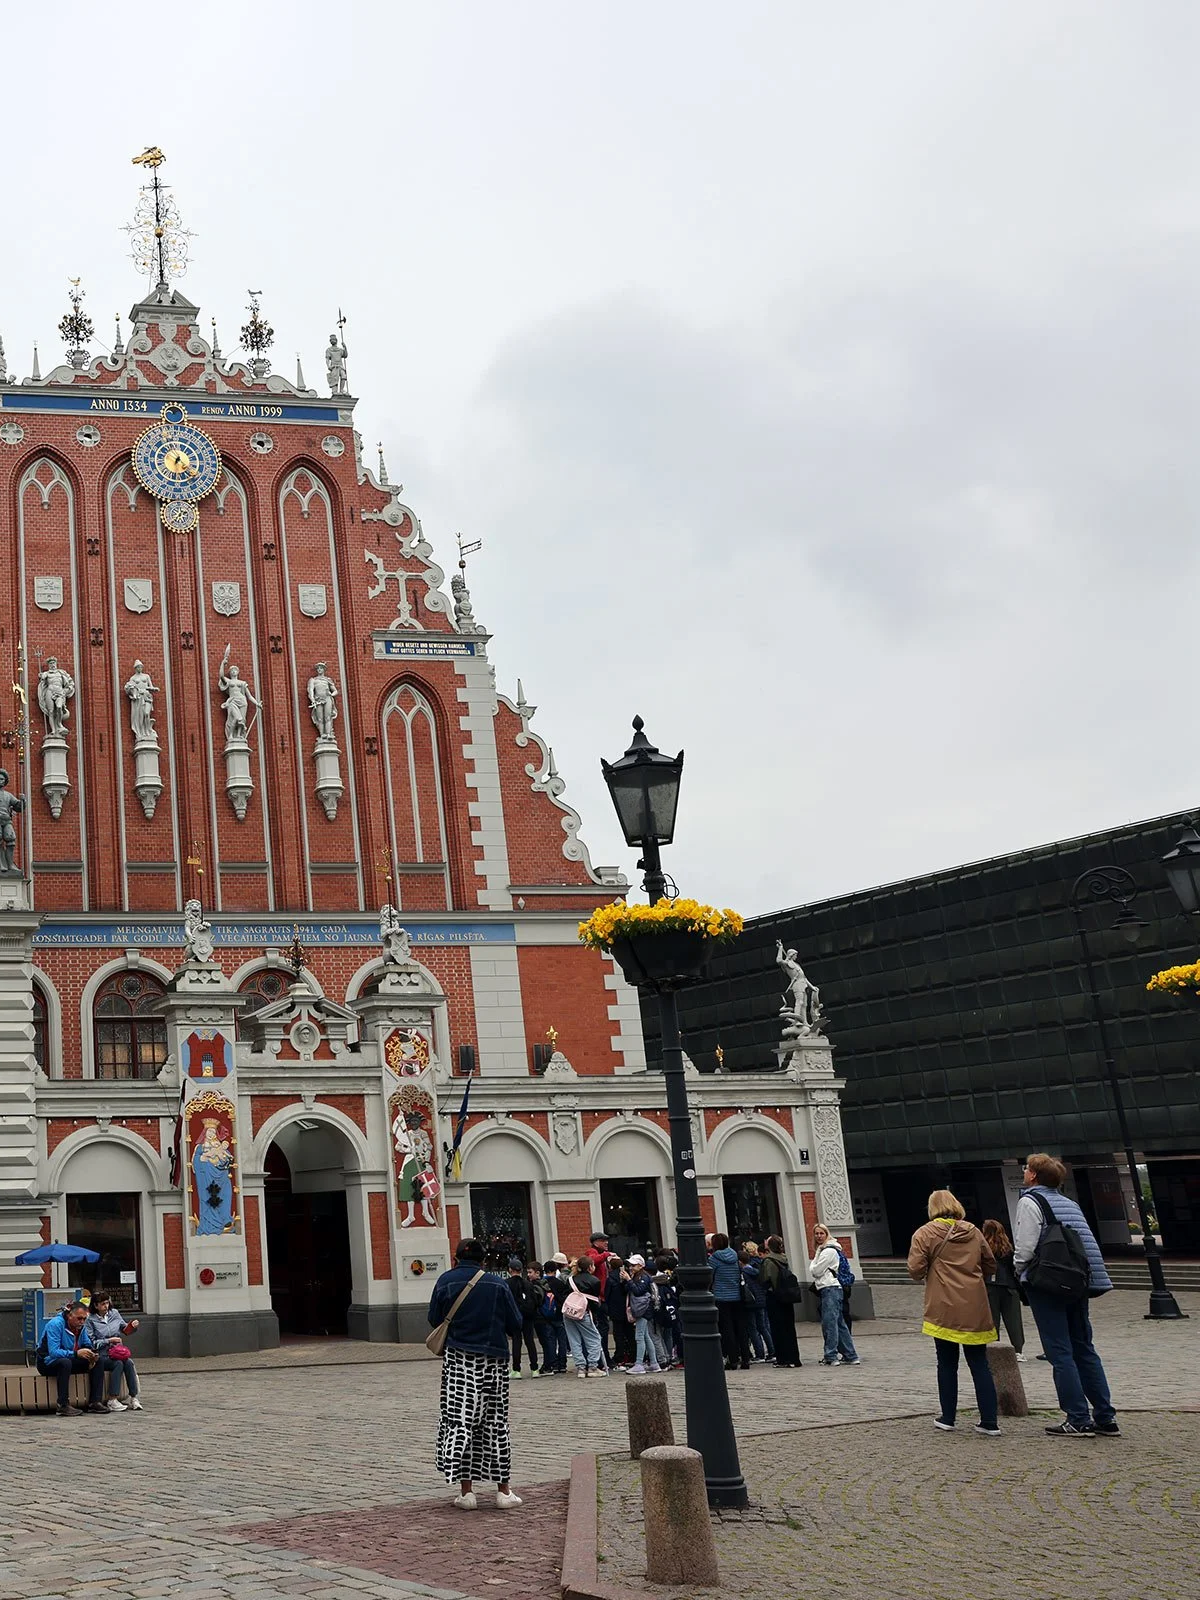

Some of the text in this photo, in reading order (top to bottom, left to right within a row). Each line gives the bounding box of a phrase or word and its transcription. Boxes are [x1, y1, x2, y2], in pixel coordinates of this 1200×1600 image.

[90, 399, 147, 412] ANNO 1334
[227, 404, 257, 416] ANNO
[260, 406, 283, 417] 1999
[116, 926, 180, 934] MELNGALVJU
[216, 926, 239, 934] TIKA
[243, 926, 291, 934] SAGRAUTS
[111, 934, 129, 942] PAR
[133, 934, 163, 942] GODU
[167, 934, 187, 942] NAM
[343, 934, 373, 942] JAUNA
[417, 932, 445, 940] RĪGAS
[802, 1151, 807, 1159] 7
